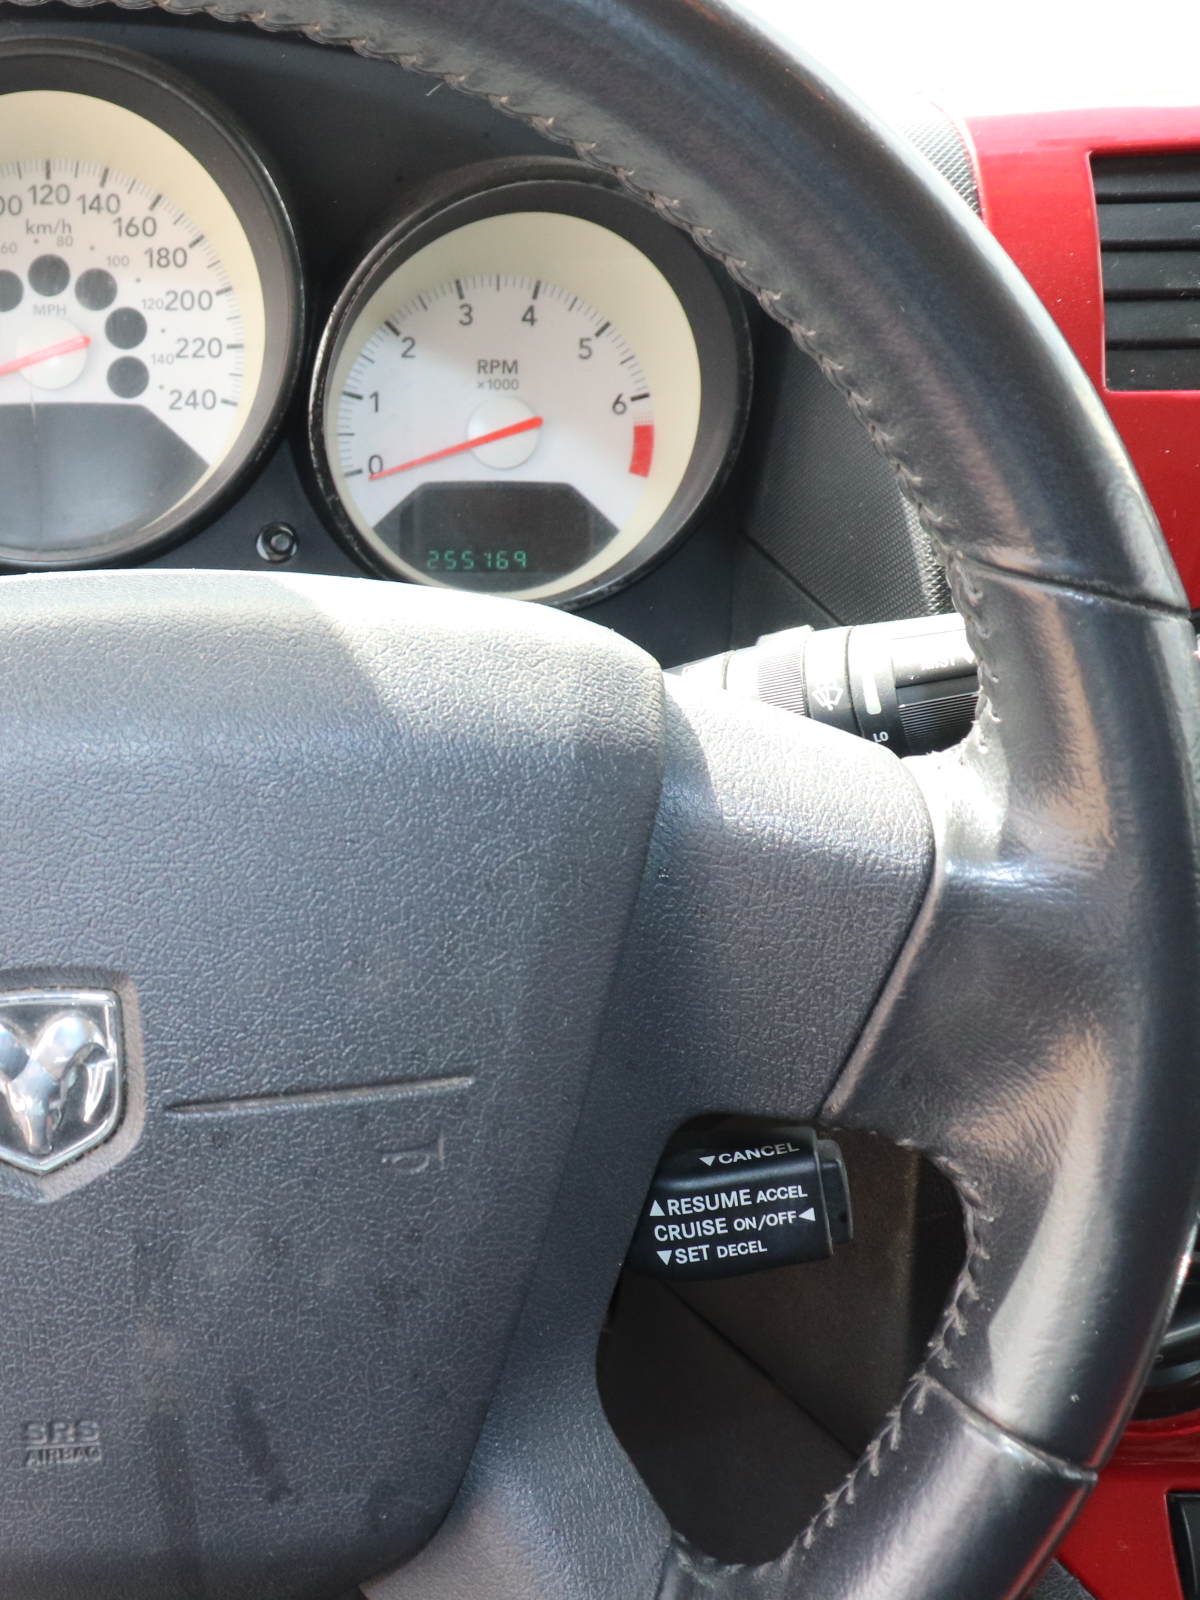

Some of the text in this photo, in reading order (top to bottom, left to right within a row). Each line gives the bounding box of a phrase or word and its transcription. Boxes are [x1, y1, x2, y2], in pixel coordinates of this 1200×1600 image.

[28, 184, 70, 205] 120
[77, 193, 121, 215] 140
[25, 218, 73, 236] km/h
[113, 216, 157, 237] 160
[0, 242, 18, 254] 60
[56, 236, 74, 248] 80
[105, 256, 130, 267] 100
[144, 247, 188, 268] 180
[33, 304, 67, 316] MPH
[142, 298, 165, 310] 120
[165, 289, 213, 311] 200
[458, 304, 474, 326] 3
[521, 305, 538, 327] 4
[175, 337, 223, 358] 220
[401, 336, 417, 359] 2
[578, 338, 593, 360] 5
[150, 353, 175, 365] 140
[477, 360, 519, 375] RPM
[168, 389, 217, 410] 240
[369, 391, 380, 413] 1
[612, 393, 628, 415] 6
[368, 455, 384, 477] 0
[426, 550, 528, 570] 255169
[873, 731, 889, 743] LO
[718, 1142, 800, 1165] CANCEL
[667, 1185, 808, 1216] RESUME ACCEL
[654, 1210, 797, 1242] CRUISE ON/OFF
[675, 1240, 768, 1265] SET DECEL
[24, 1420, 100, 1445] SRS
[25, 1447, 102, 1467] AIRBAG
